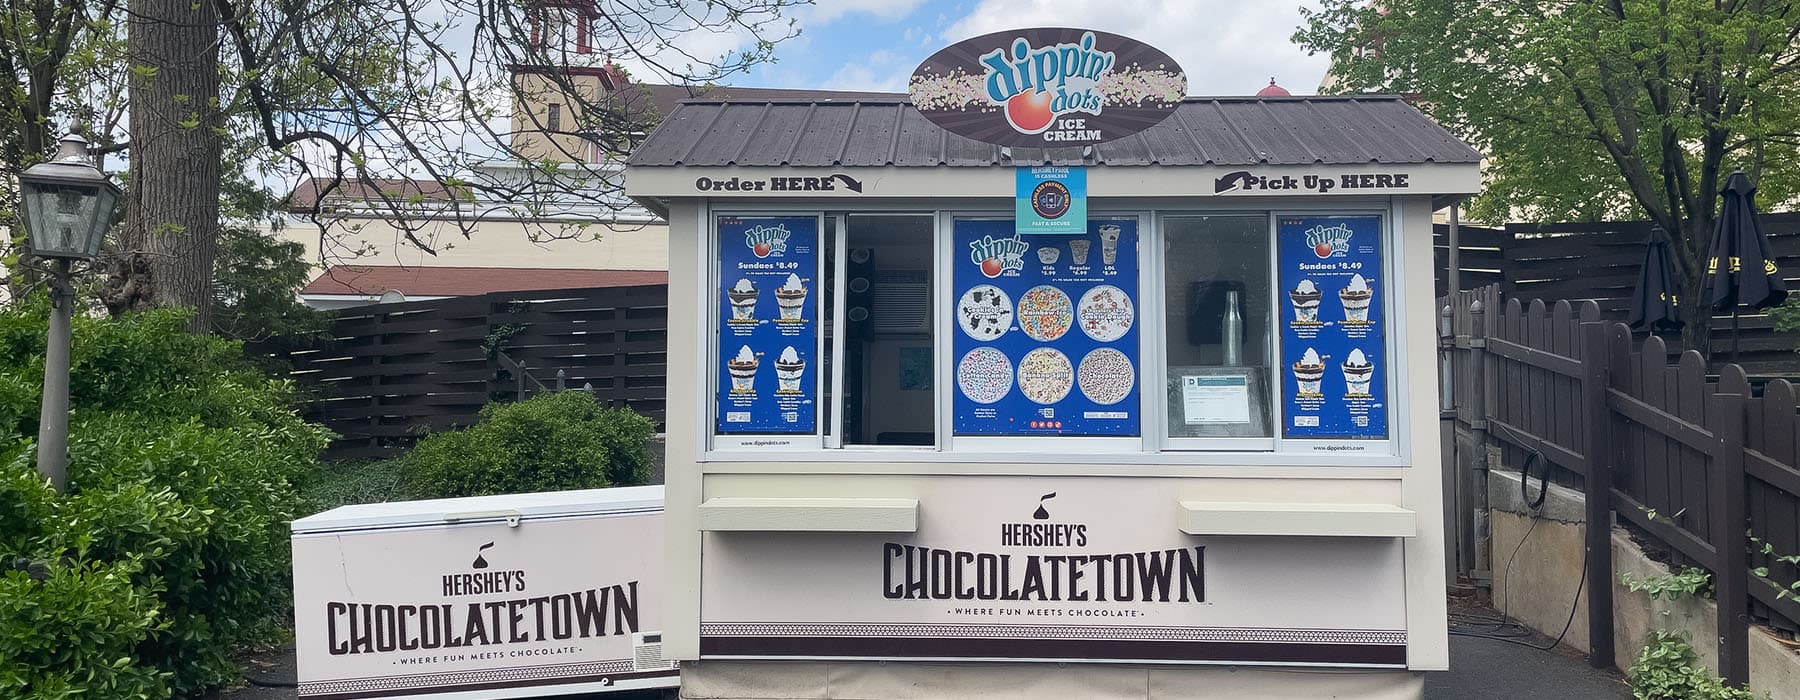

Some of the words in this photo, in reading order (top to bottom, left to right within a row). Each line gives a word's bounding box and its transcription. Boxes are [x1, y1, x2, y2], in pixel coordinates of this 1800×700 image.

[983, 35, 1111, 101] dippin'
[1051, 87, 1099, 112] dots
[1058, 119, 1086, 130] ICE
[1043, 131, 1102, 142] CREAM
[696, 177, 766, 191] Order
[770, 177, 835, 191] HERE
[1243, 174, 1298, 190] Pick
[1303, 175, 1335, 192] Up
[1341, 174, 1409, 188] HERE
[970, 235, 1028, 263] dippin'
[1001, 256, 1022, 269] dots
[1299, 262, 1336, 270] Sundaes
[1001, 523, 1087, 547] HERSHEY'S
[883, 542, 1206, 603] CHOCOLATETOWN
[442, 570, 526, 597] HERSHEY'S
[327, 581, 638, 656] CHOCOLATETOWN
[955, 608, 994, 616] WHERE
[999, 608, 1021, 616] FUN
[1027, 609, 1063, 617] MEETS
[1068, 609, 1137, 618] CHOCOLATE
[400, 656, 438, 665] WHERE
[443, 653, 465, 662] FUN
[470, 651, 504, 660] MEETS
[509, 646, 576, 658] CHOCOLATE
